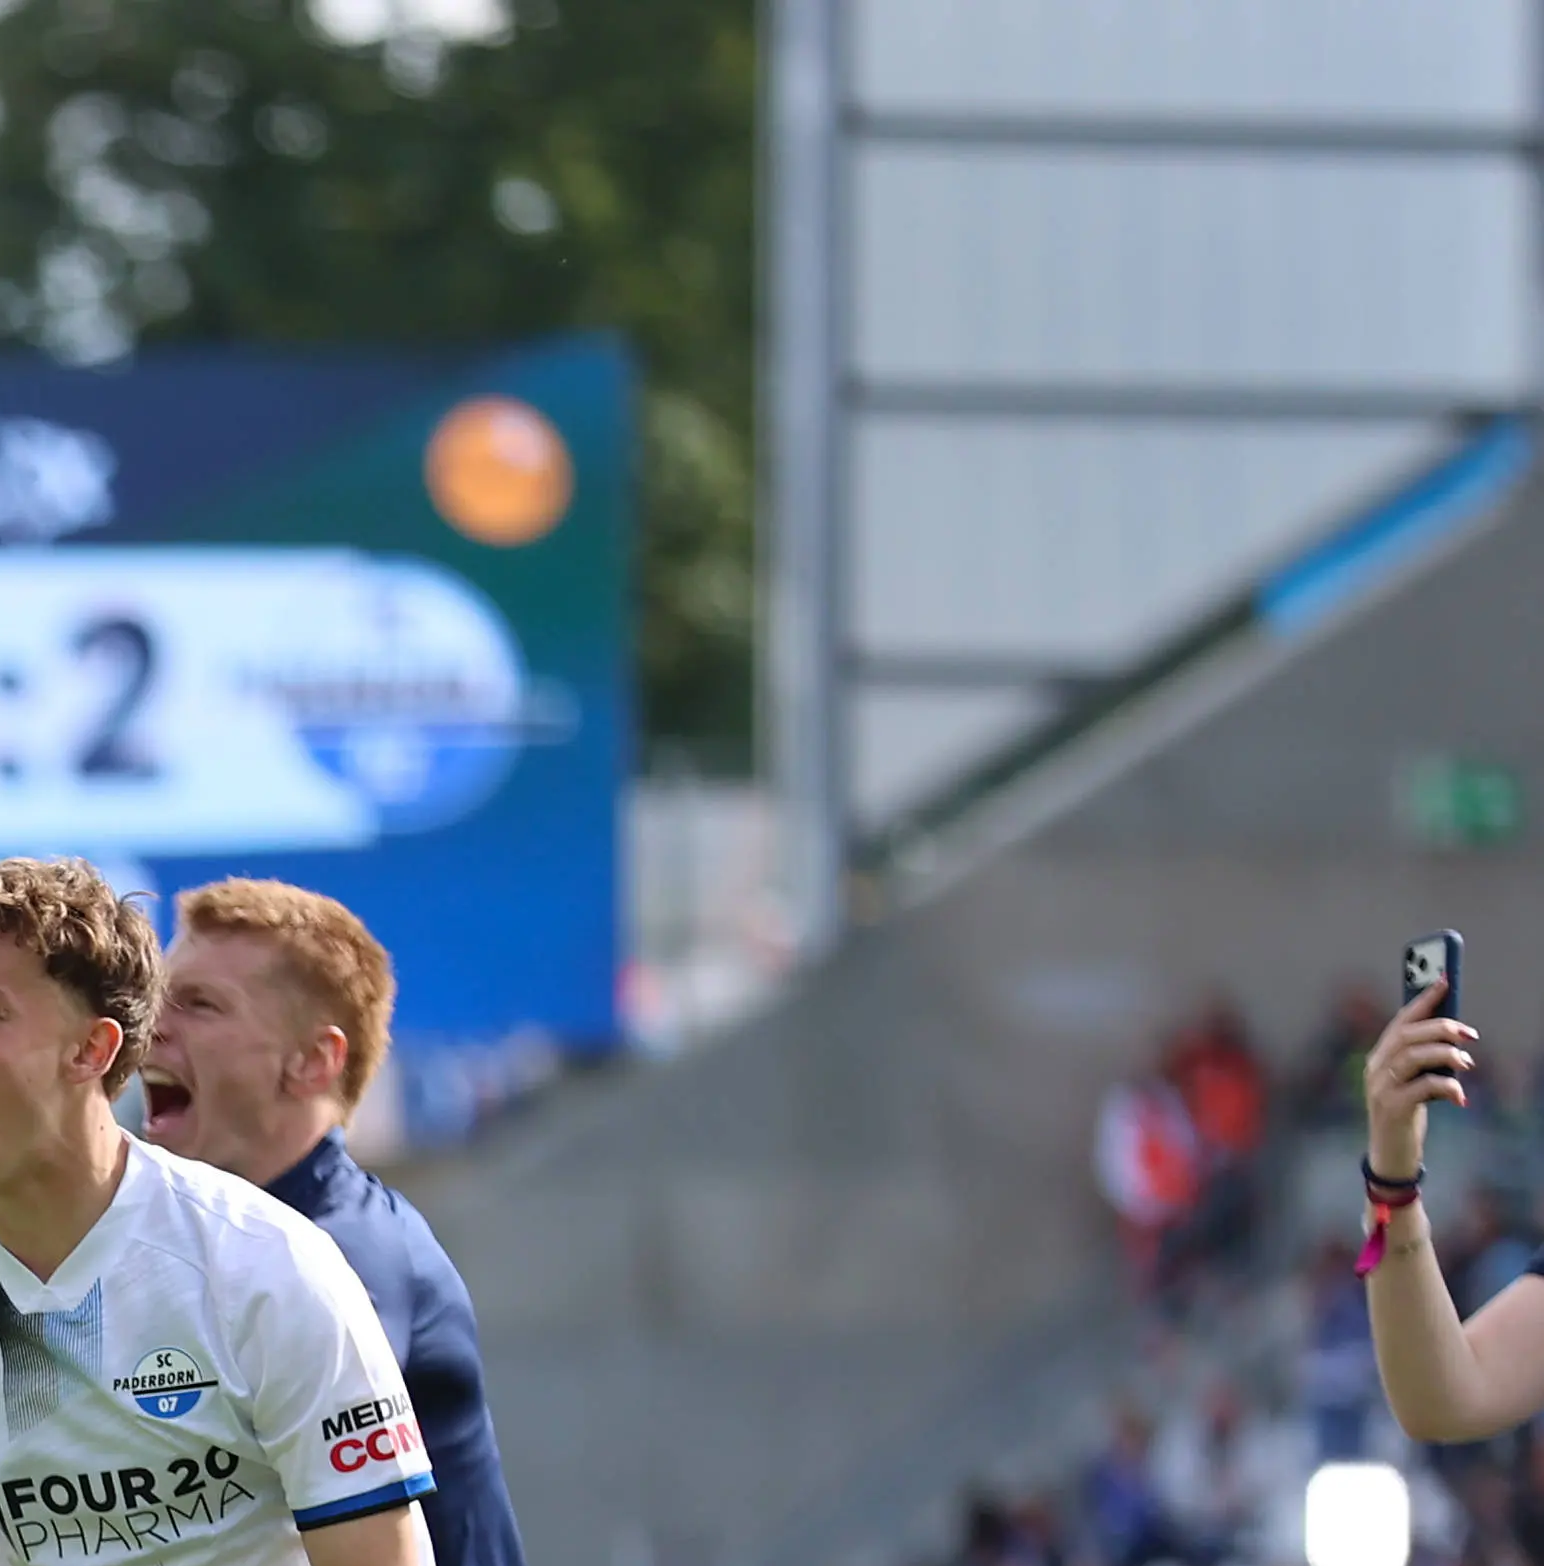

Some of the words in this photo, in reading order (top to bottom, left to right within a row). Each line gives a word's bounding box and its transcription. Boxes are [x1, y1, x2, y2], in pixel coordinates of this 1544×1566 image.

[113, 1370, 196, 1392] PADERBORN
[156, 1353, 173, 1369] SC
[158, 1396, 180, 1413] 07
[321, 1392, 412, 1442] MEDIA
[329, 1418, 422, 1474] COM
[1, 1466, 163, 1521] FOUR
[167, 1445, 240, 1498] 20
[15, 1479, 256, 1562] PHARMA
